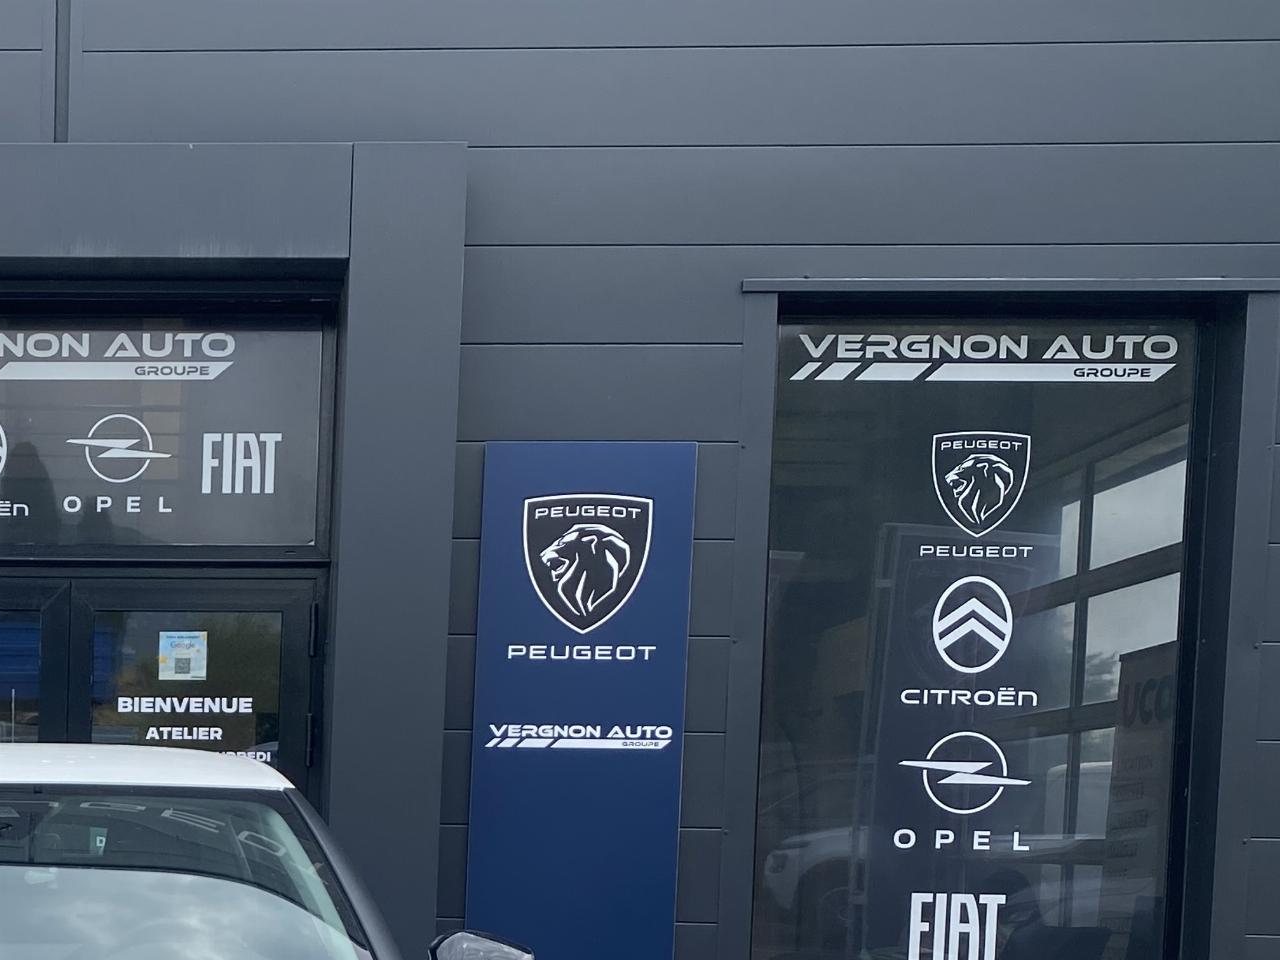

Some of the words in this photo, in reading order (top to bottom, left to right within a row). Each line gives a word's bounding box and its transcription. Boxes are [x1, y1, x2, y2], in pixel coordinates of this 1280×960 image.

[103, 333, 236, 358] AUTO
[799, 334, 1028, 359] VERGNON
[1042, 335, 1178, 360] AUTO
[134, 365, 210, 376] GROUPE
[1073, 367, 1152, 378] GROUPE
[940, 440, 1023, 451] PEUGEOT
[201, 432, 282, 494] FIAT
[63, 496, 172, 513] OPEL
[535, 505, 641, 519] PEUGEOT
[920, 546, 1033, 558] PEUGEOT
[507, 645, 656, 660] PEUGEOT
[117, 697, 253, 714] BIENVENUE
[146, 726, 223, 741] ATELIER
[489, 725, 600, 738] VERGNON
[607, 725, 672, 739] AUTO
[893, 828, 1030, 850] OPEL
